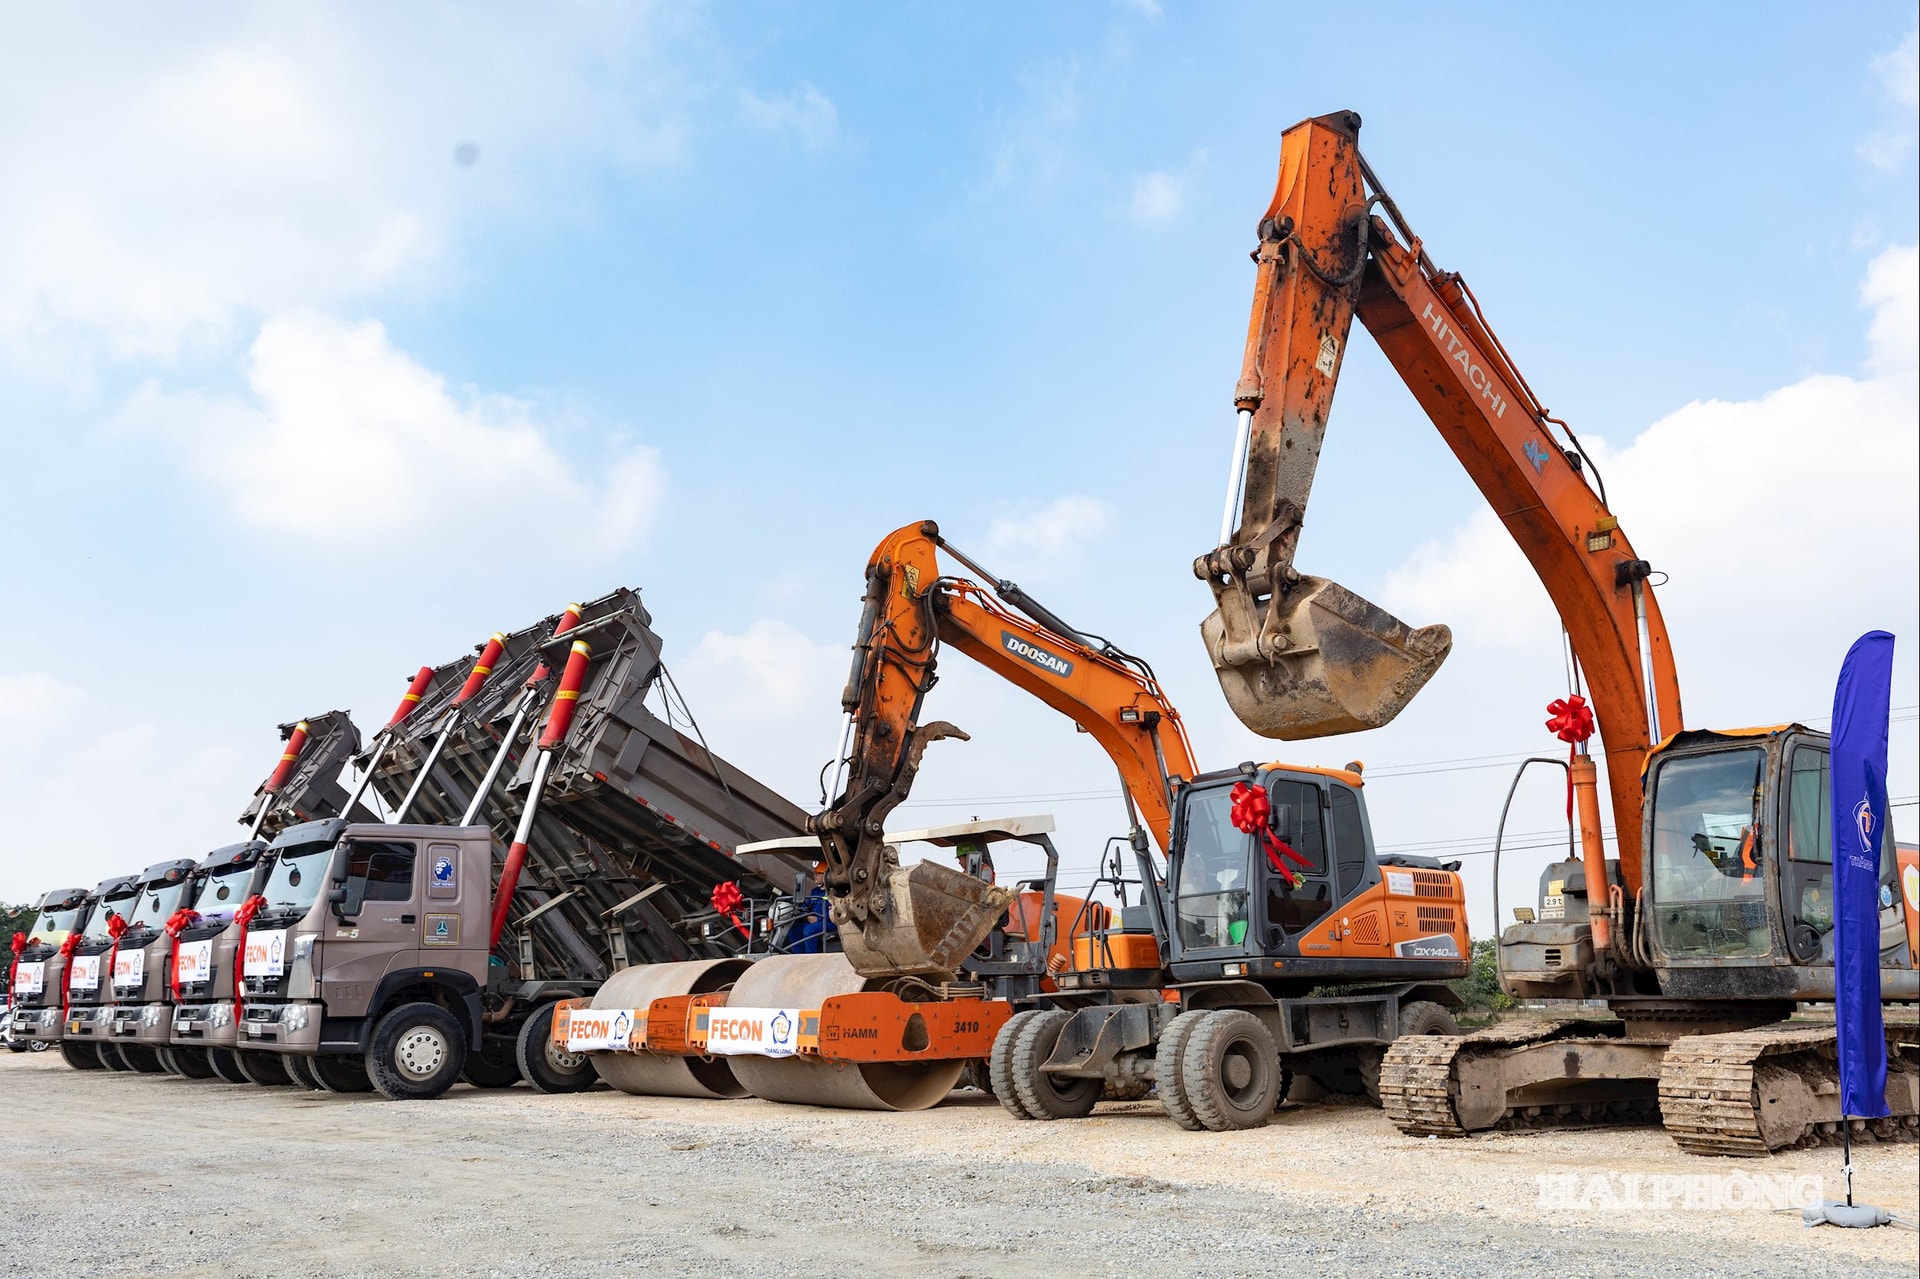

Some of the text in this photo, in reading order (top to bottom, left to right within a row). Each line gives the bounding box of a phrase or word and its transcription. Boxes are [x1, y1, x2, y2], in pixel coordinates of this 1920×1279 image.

[1422, 302, 1507, 418] HITACHI
[1006, 637, 1069, 675] DOOSAN
[246, 944, 268, 964] FECON
[570, 1019, 610, 1040] FECON
[711, 1018, 763, 1042] FECON
[843, 1027, 878, 1039] HAMM
[953, 1020, 979, 1034] 3410
